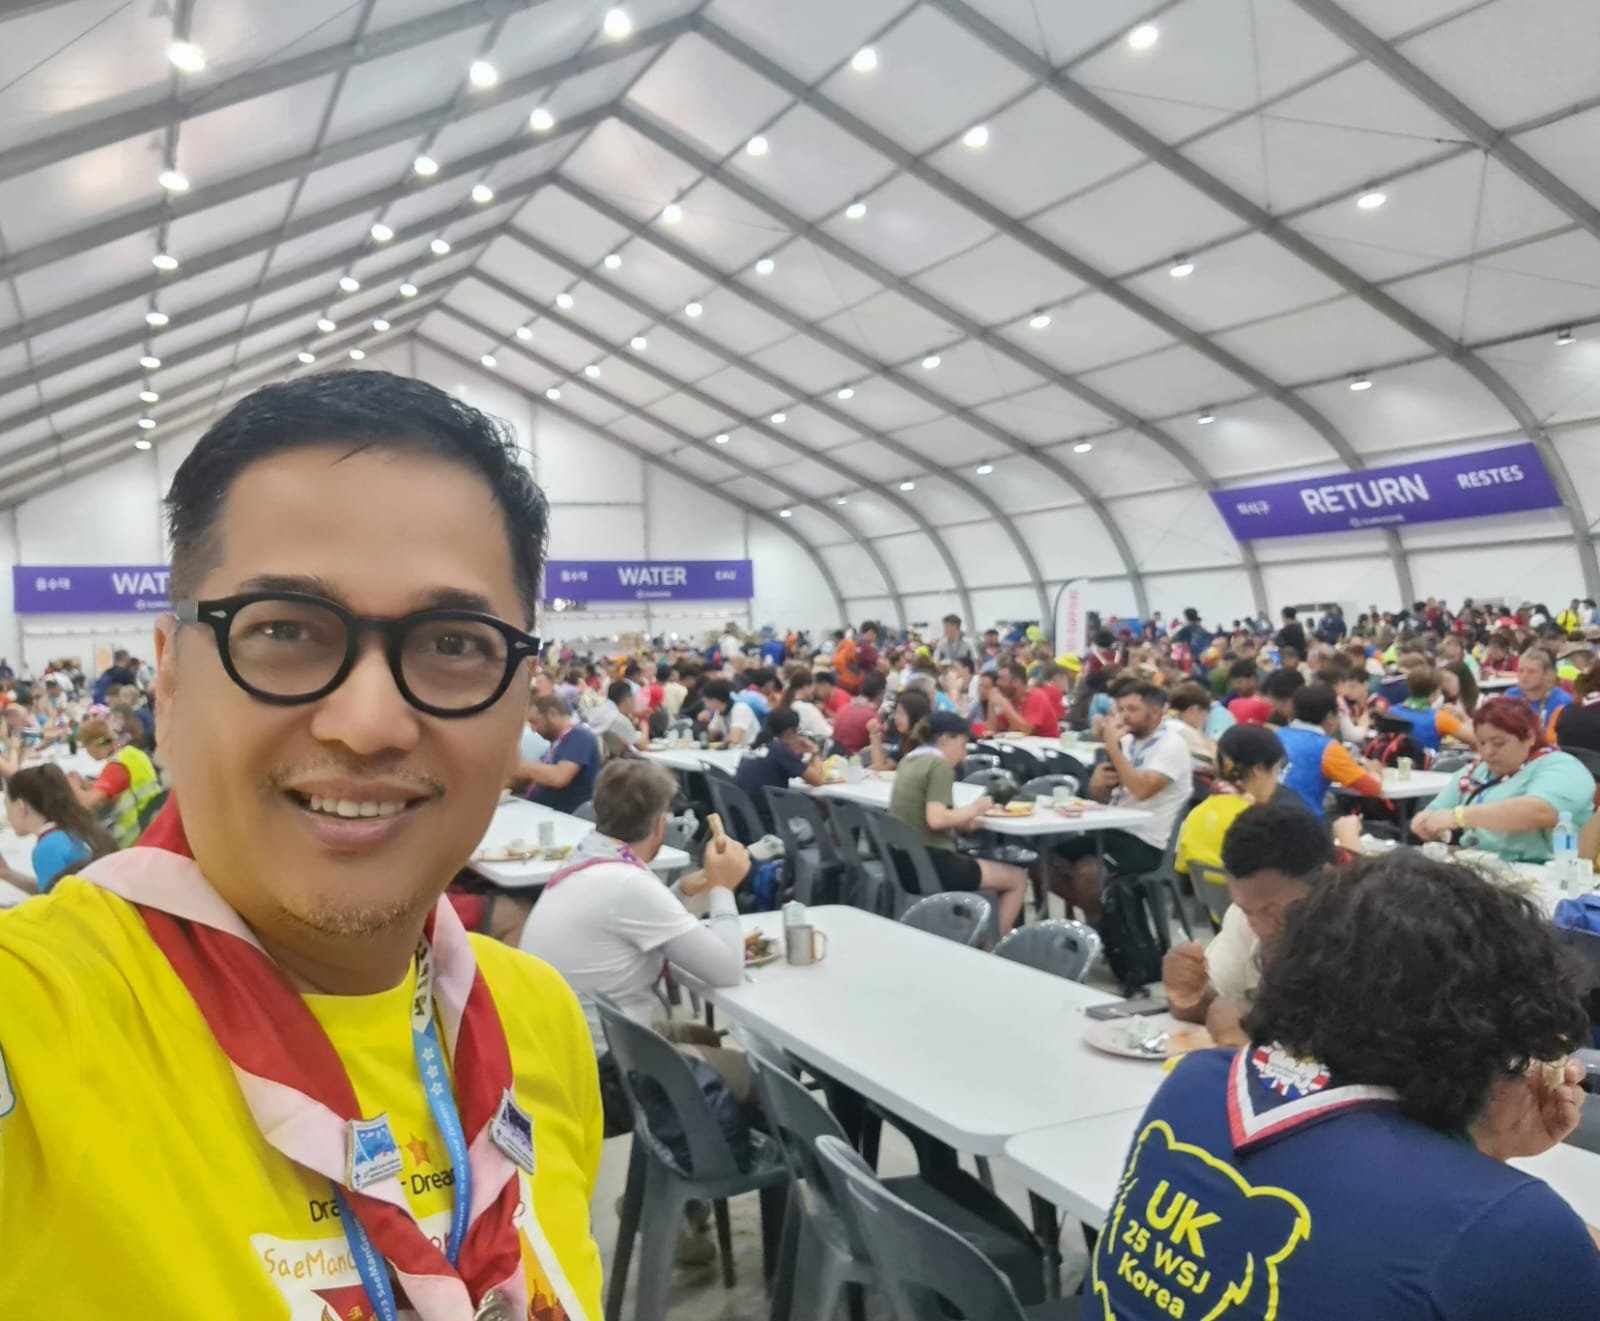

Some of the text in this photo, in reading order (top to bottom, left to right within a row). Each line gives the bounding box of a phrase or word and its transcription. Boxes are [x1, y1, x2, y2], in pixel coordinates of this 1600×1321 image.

[1457, 465, 1524, 490] RESTES
[1300, 474, 1431, 515] RETURN
[112, 571, 170, 595] WAT
[617, 566, 688, 586] WATER
[411, 1167, 456, 1195] Drea
[309, 1199, 342, 1223] Dra
[1146, 1180, 1222, 1258] UK
[1121, 1219, 1211, 1294] 25 WSJ
[1117, 1251, 1186, 1320] Korea
